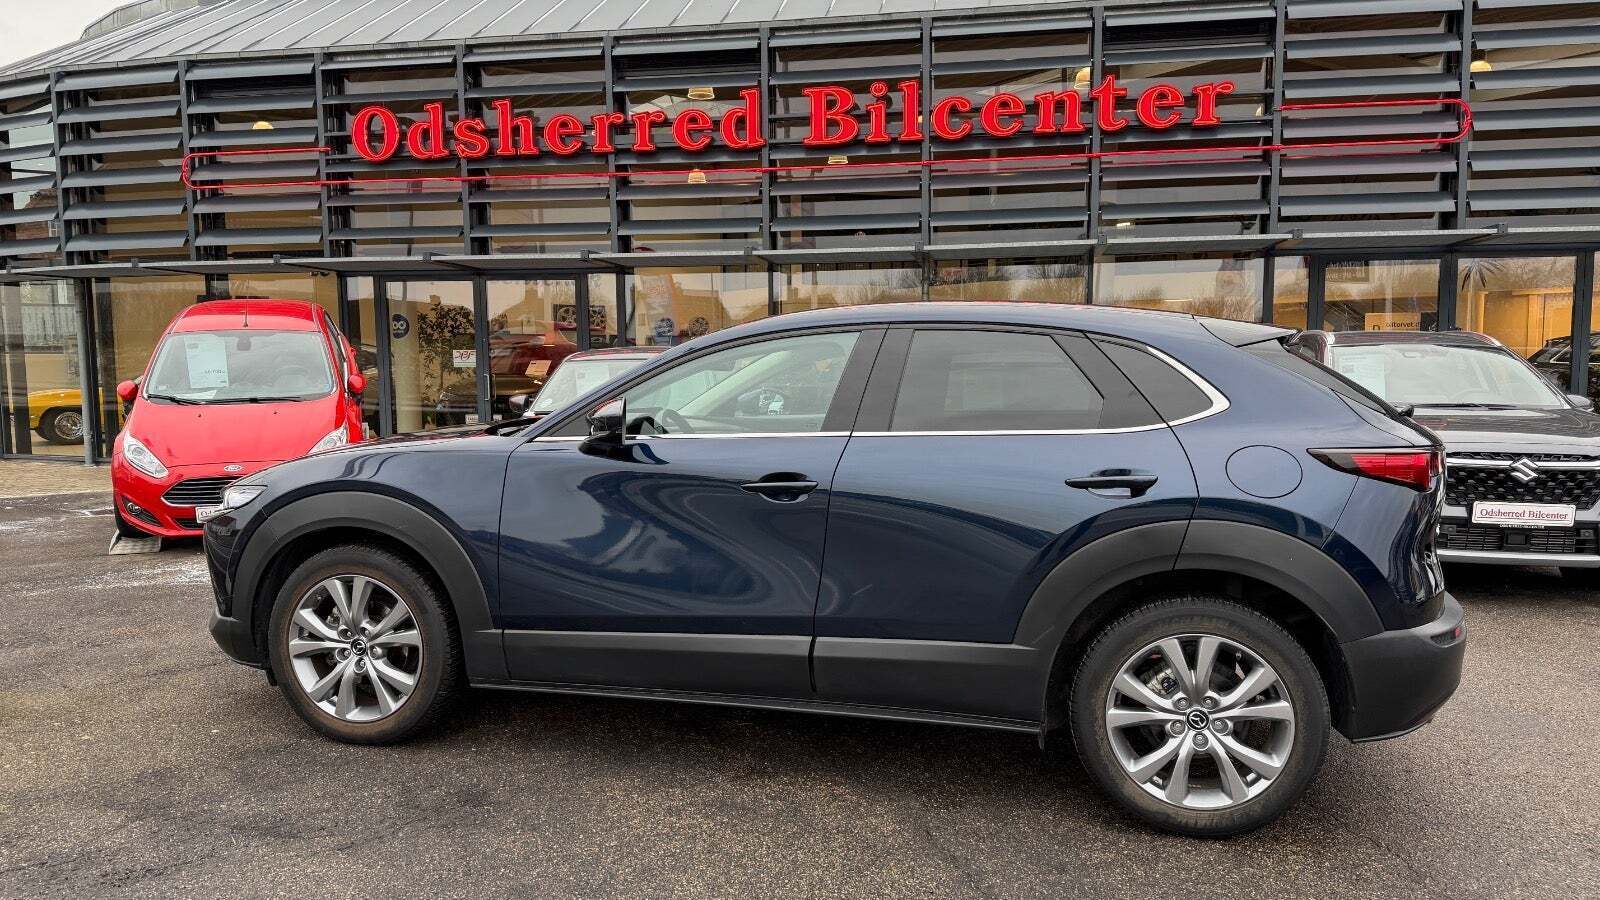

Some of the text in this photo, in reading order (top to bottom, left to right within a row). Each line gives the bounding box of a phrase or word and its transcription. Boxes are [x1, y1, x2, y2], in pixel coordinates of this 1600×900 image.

[351, 74, 1236, 162] Odsherred Bilcenter
[1480, 508, 1568, 520] Odsherred Bilcenter
